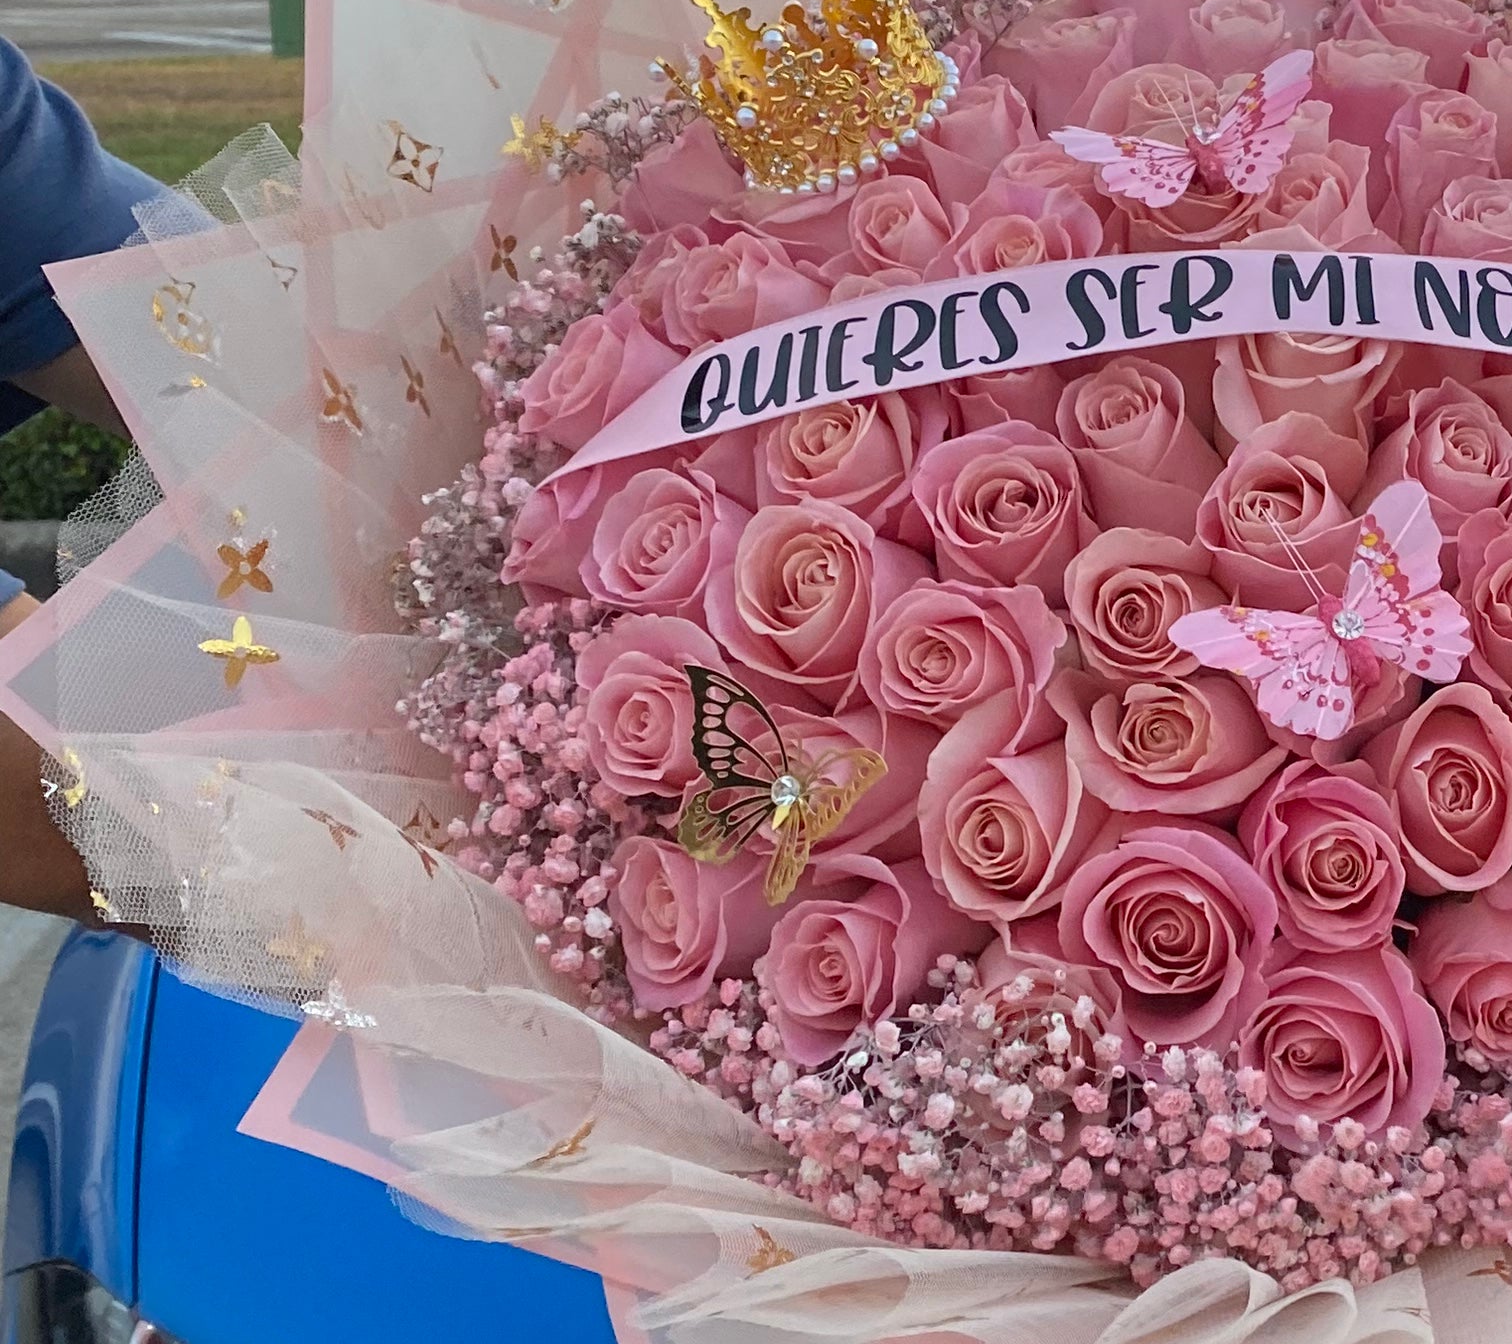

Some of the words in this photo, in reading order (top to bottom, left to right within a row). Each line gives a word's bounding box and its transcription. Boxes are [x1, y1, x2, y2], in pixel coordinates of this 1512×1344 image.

[680, 281, 1031, 434] QUIERES
[1065, 255, 1234, 351] SER
[1271, 254, 1381, 326] MI
